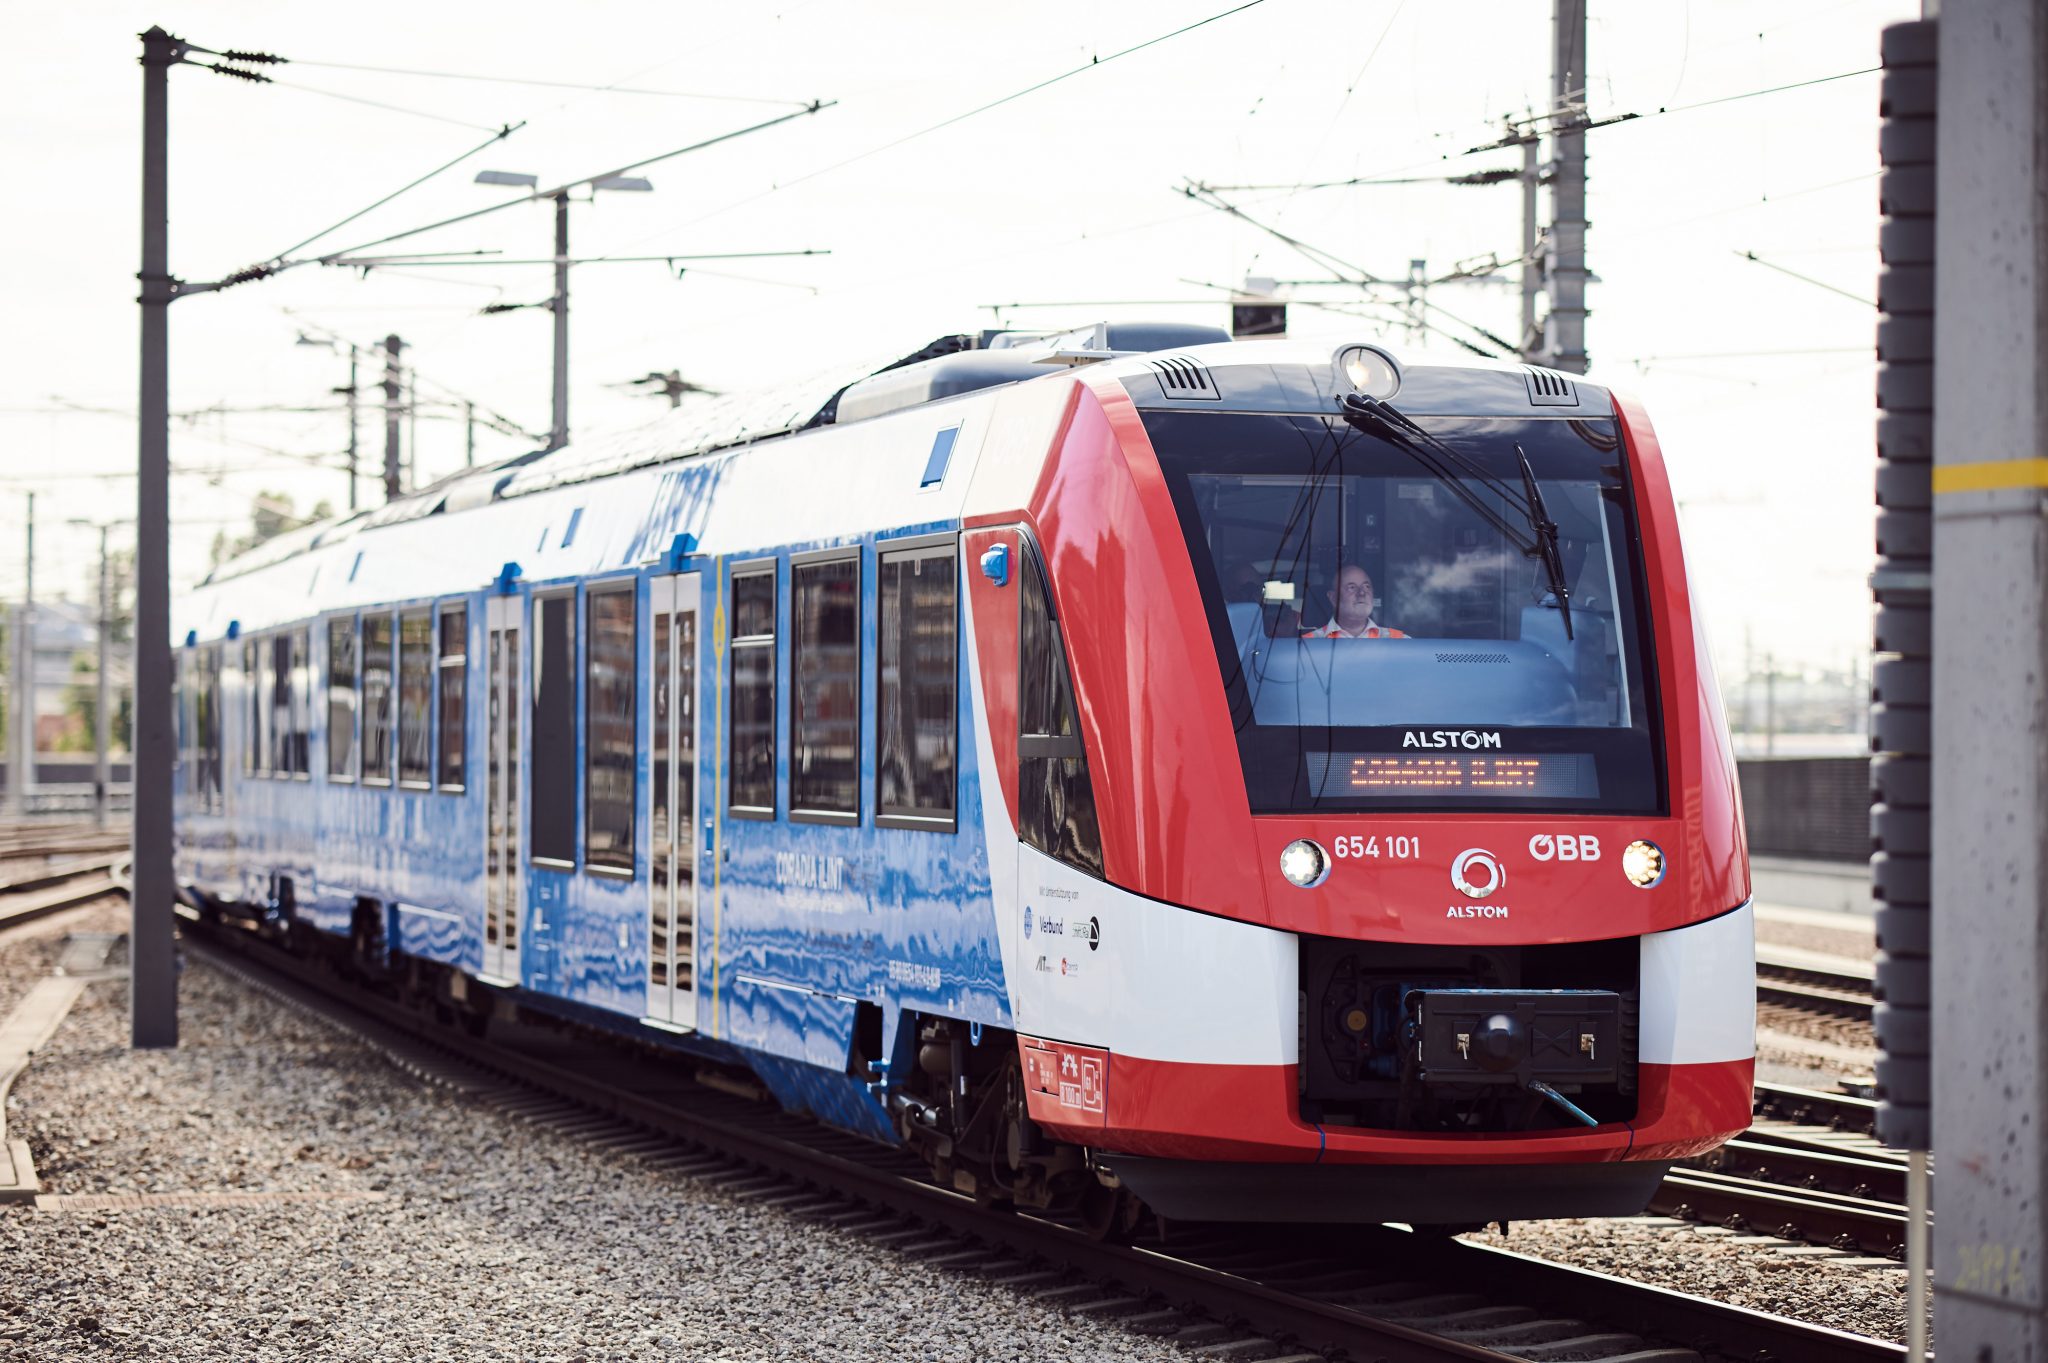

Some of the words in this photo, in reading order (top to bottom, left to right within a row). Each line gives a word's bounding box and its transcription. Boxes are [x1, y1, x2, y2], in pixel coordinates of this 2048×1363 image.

[1402, 730, 1502, 750] ALSTOM
[1334, 836, 1380, 859] 654
[1385, 836, 1420, 859] 101
[1528, 833, 1601, 862] ÖBB
[1446, 905, 1509, 919] ALSTOM
[1039, 916, 1063, 935] Verbund
